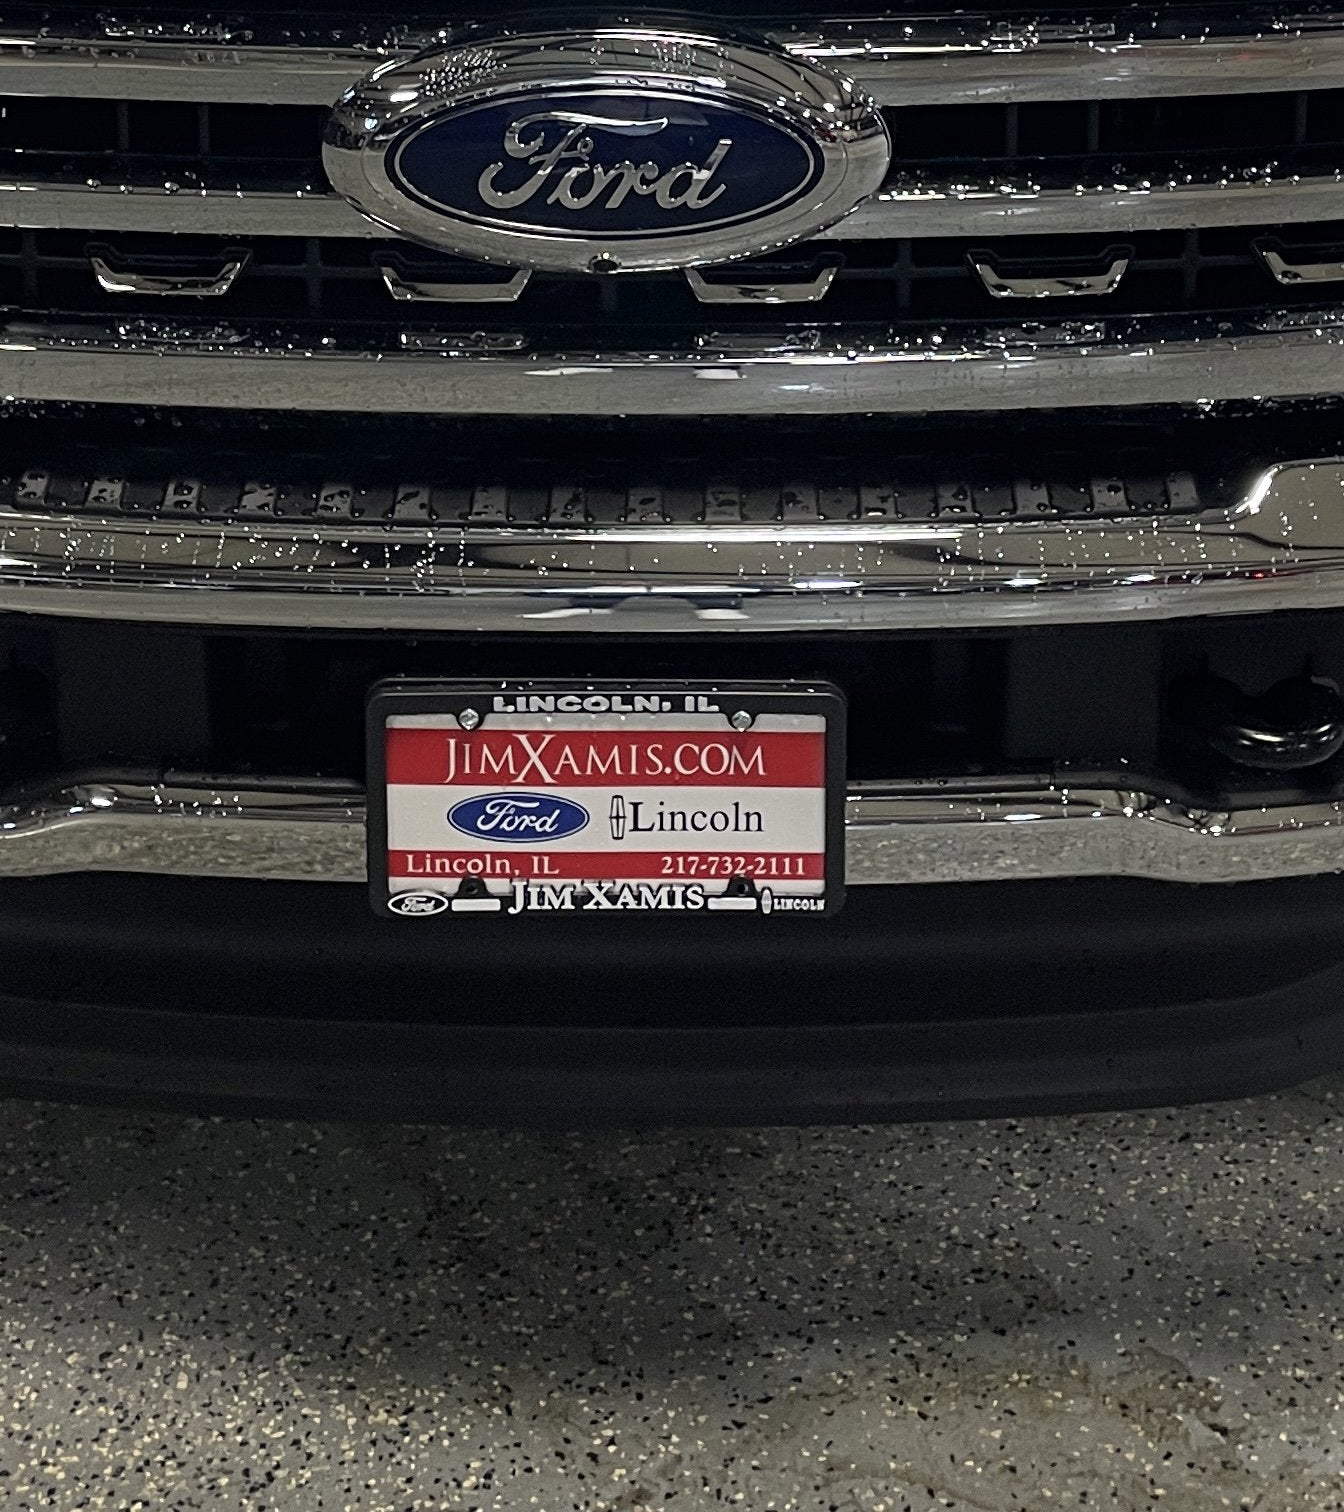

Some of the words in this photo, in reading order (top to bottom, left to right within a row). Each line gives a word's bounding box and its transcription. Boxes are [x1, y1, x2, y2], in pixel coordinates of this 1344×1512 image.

[478, 110, 733, 210] Ford
[493, 696, 672, 713] LINCOLN,
[683, 696, 720, 713] IL
[444, 733, 767, 785] JIMXAMIS.COM
[476, 800, 561, 834] Ford
[627, 801, 764, 833] Lincoln
[406, 854, 521, 876] Lincoln,
[531, 855, 560, 875] IL
[661, 855, 806, 876] 217-732-2111
[507, 880, 576, 915] JIM
[583, 881, 705, 910] XAMIS
[773, 897, 826, 911] LINCOLN
